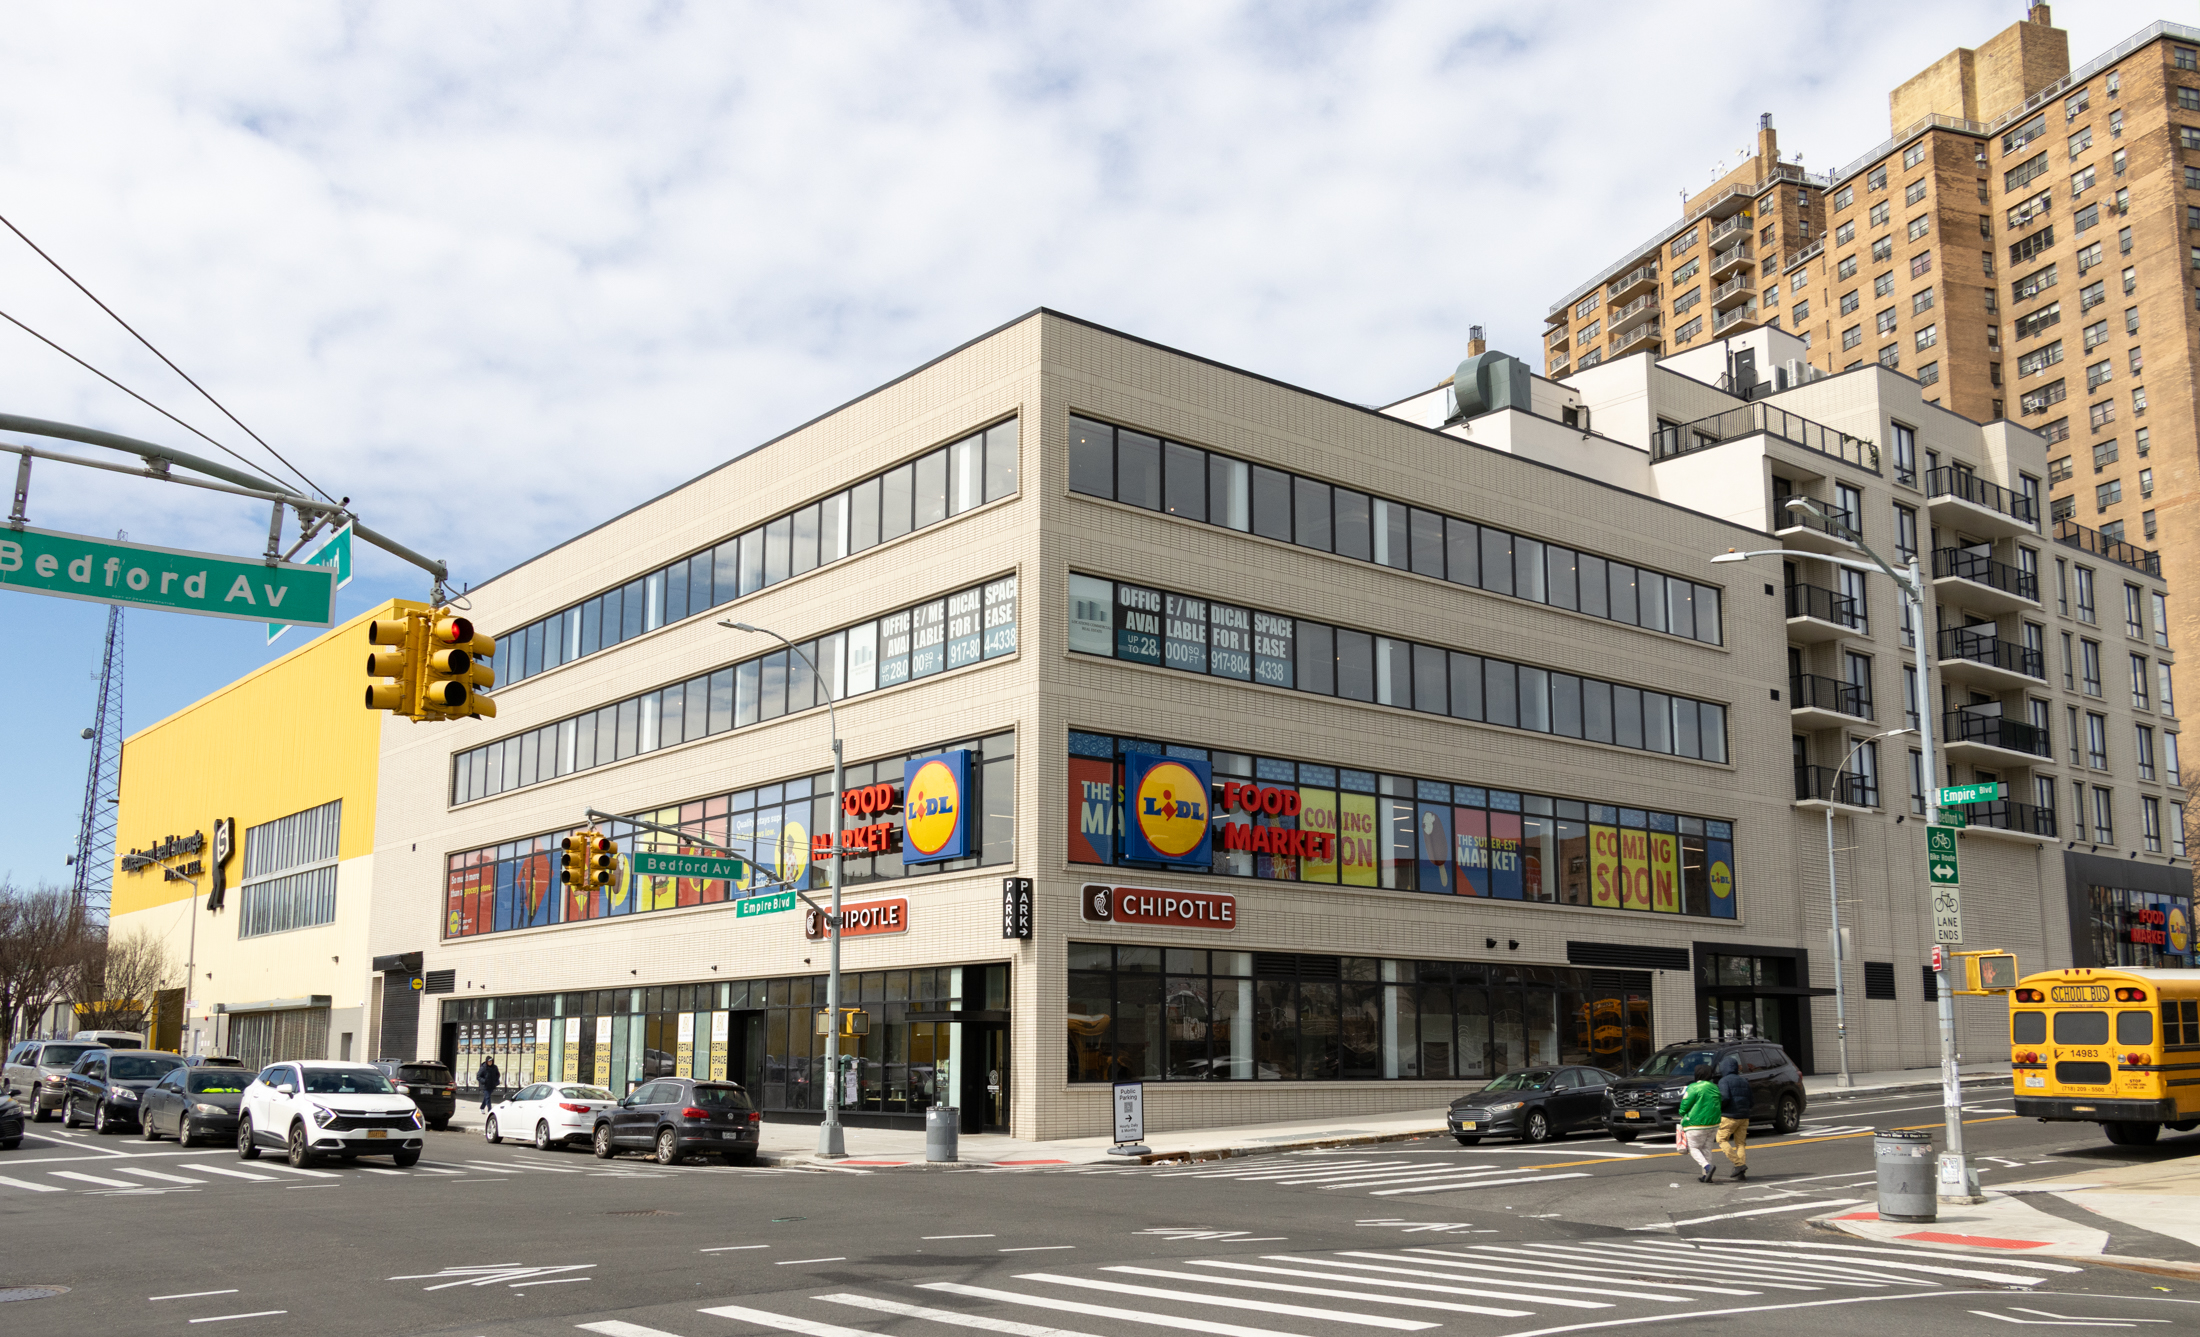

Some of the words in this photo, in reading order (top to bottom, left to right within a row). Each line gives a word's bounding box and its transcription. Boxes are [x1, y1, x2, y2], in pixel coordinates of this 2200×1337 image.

[0, 541, 208, 599] Bedford
[224, 574, 288, 607] Av
[882, 607, 920, 637] OFFICE
[928, 590, 980, 623] MEDICAL
[1120, 586, 1174, 615] OFFICE
[1185, 600, 1249, 630] MEDICAL
[1254, 614, 1292, 639] SPACE
[887, 623, 944, 658] AVAILABLE
[950, 617, 970, 639] FOR
[975, 602, 1013, 632] LEASE
[1125, 611, 1206, 644] AVAILABLE
[1213, 628, 1239, 650] FOR
[1244, 633, 1286, 659] LEASE
[881, 665, 890, 674] UP
[925, 651, 933, 662] SQ
[950, 627, 1016, 664] 917-804-4338
[1128, 644, 1139, 654] TO
[1189, 655, 1199, 666] FT
[1128, 635, 1139, 644] UP
[1141, 636, 1188, 662] 28,000
[1188, 645, 1199, 655] SQ
[1211, 650, 1284, 682] 917-804-4338
[881, 674, 890, 683] TO
[925, 661, 933, 671] FT
[1081, 780, 1110, 802] THE
[1224, 781, 1302, 817] FOOD
[1943, 788, 1976, 804] Empire
[1979, 786, 1992, 794] Blvd
[1304, 807, 1372, 834] COMING
[1224, 822, 1335, 860] MARKET
[1457, 833, 1473, 847] THE
[1595, 830, 1671, 864] COMING
[647, 857, 709, 875] Bedford
[712, 863, 731, 875] Av
[1457, 846, 1517, 872] MARKET
[1930, 853, 1940, 861] Bike
[1941, 854, 1956, 862] Route
[464, 886, 478, 898] grocery
[480, 884, 491, 893] store
[1596, 862, 1673, 907] SOON
[743, 901, 772, 915] Empire
[773, 896, 790, 910] Blvd
[1005, 880, 1013, 927] PARK
[1019, 881, 1029, 927] PARK
[1122, 895, 1233, 922] CHIPOTLE
[1937, 916, 1958, 927] LANE
[2139, 909, 2165, 925] FOOD
[1938, 929, 1959, 940] ENDS
[2131, 928, 2167, 945] MARKET
[2052, 986, 2087, 1001] SCHOOL
[2090, 986, 2109, 1001] BUS
[597, 1044, 610, 1052] RETAIL
[678, 1043, 693, 1052] RETAIL
[712, 1043, 727, 1052] RETAIL
[2070, 1049, 2099, 1058] 14983
[566, 1053, 578, 1061] SPACE
[597, 1055, 610, 1063] SPACE
[678, 1055, 692, 1065] SPACE
[712, 1055, 727, 1065] SPACE
[567, 1063, 576, 1071] FOR
[598, 1066, 607, 1074] FOR
[680, 1068, 689, 1077] FOR
[714, 1067, 723, 1077] FOR
[565, 1074, 577, 1082] LEASE
[596, 1077, 609, 1086] LEASE
